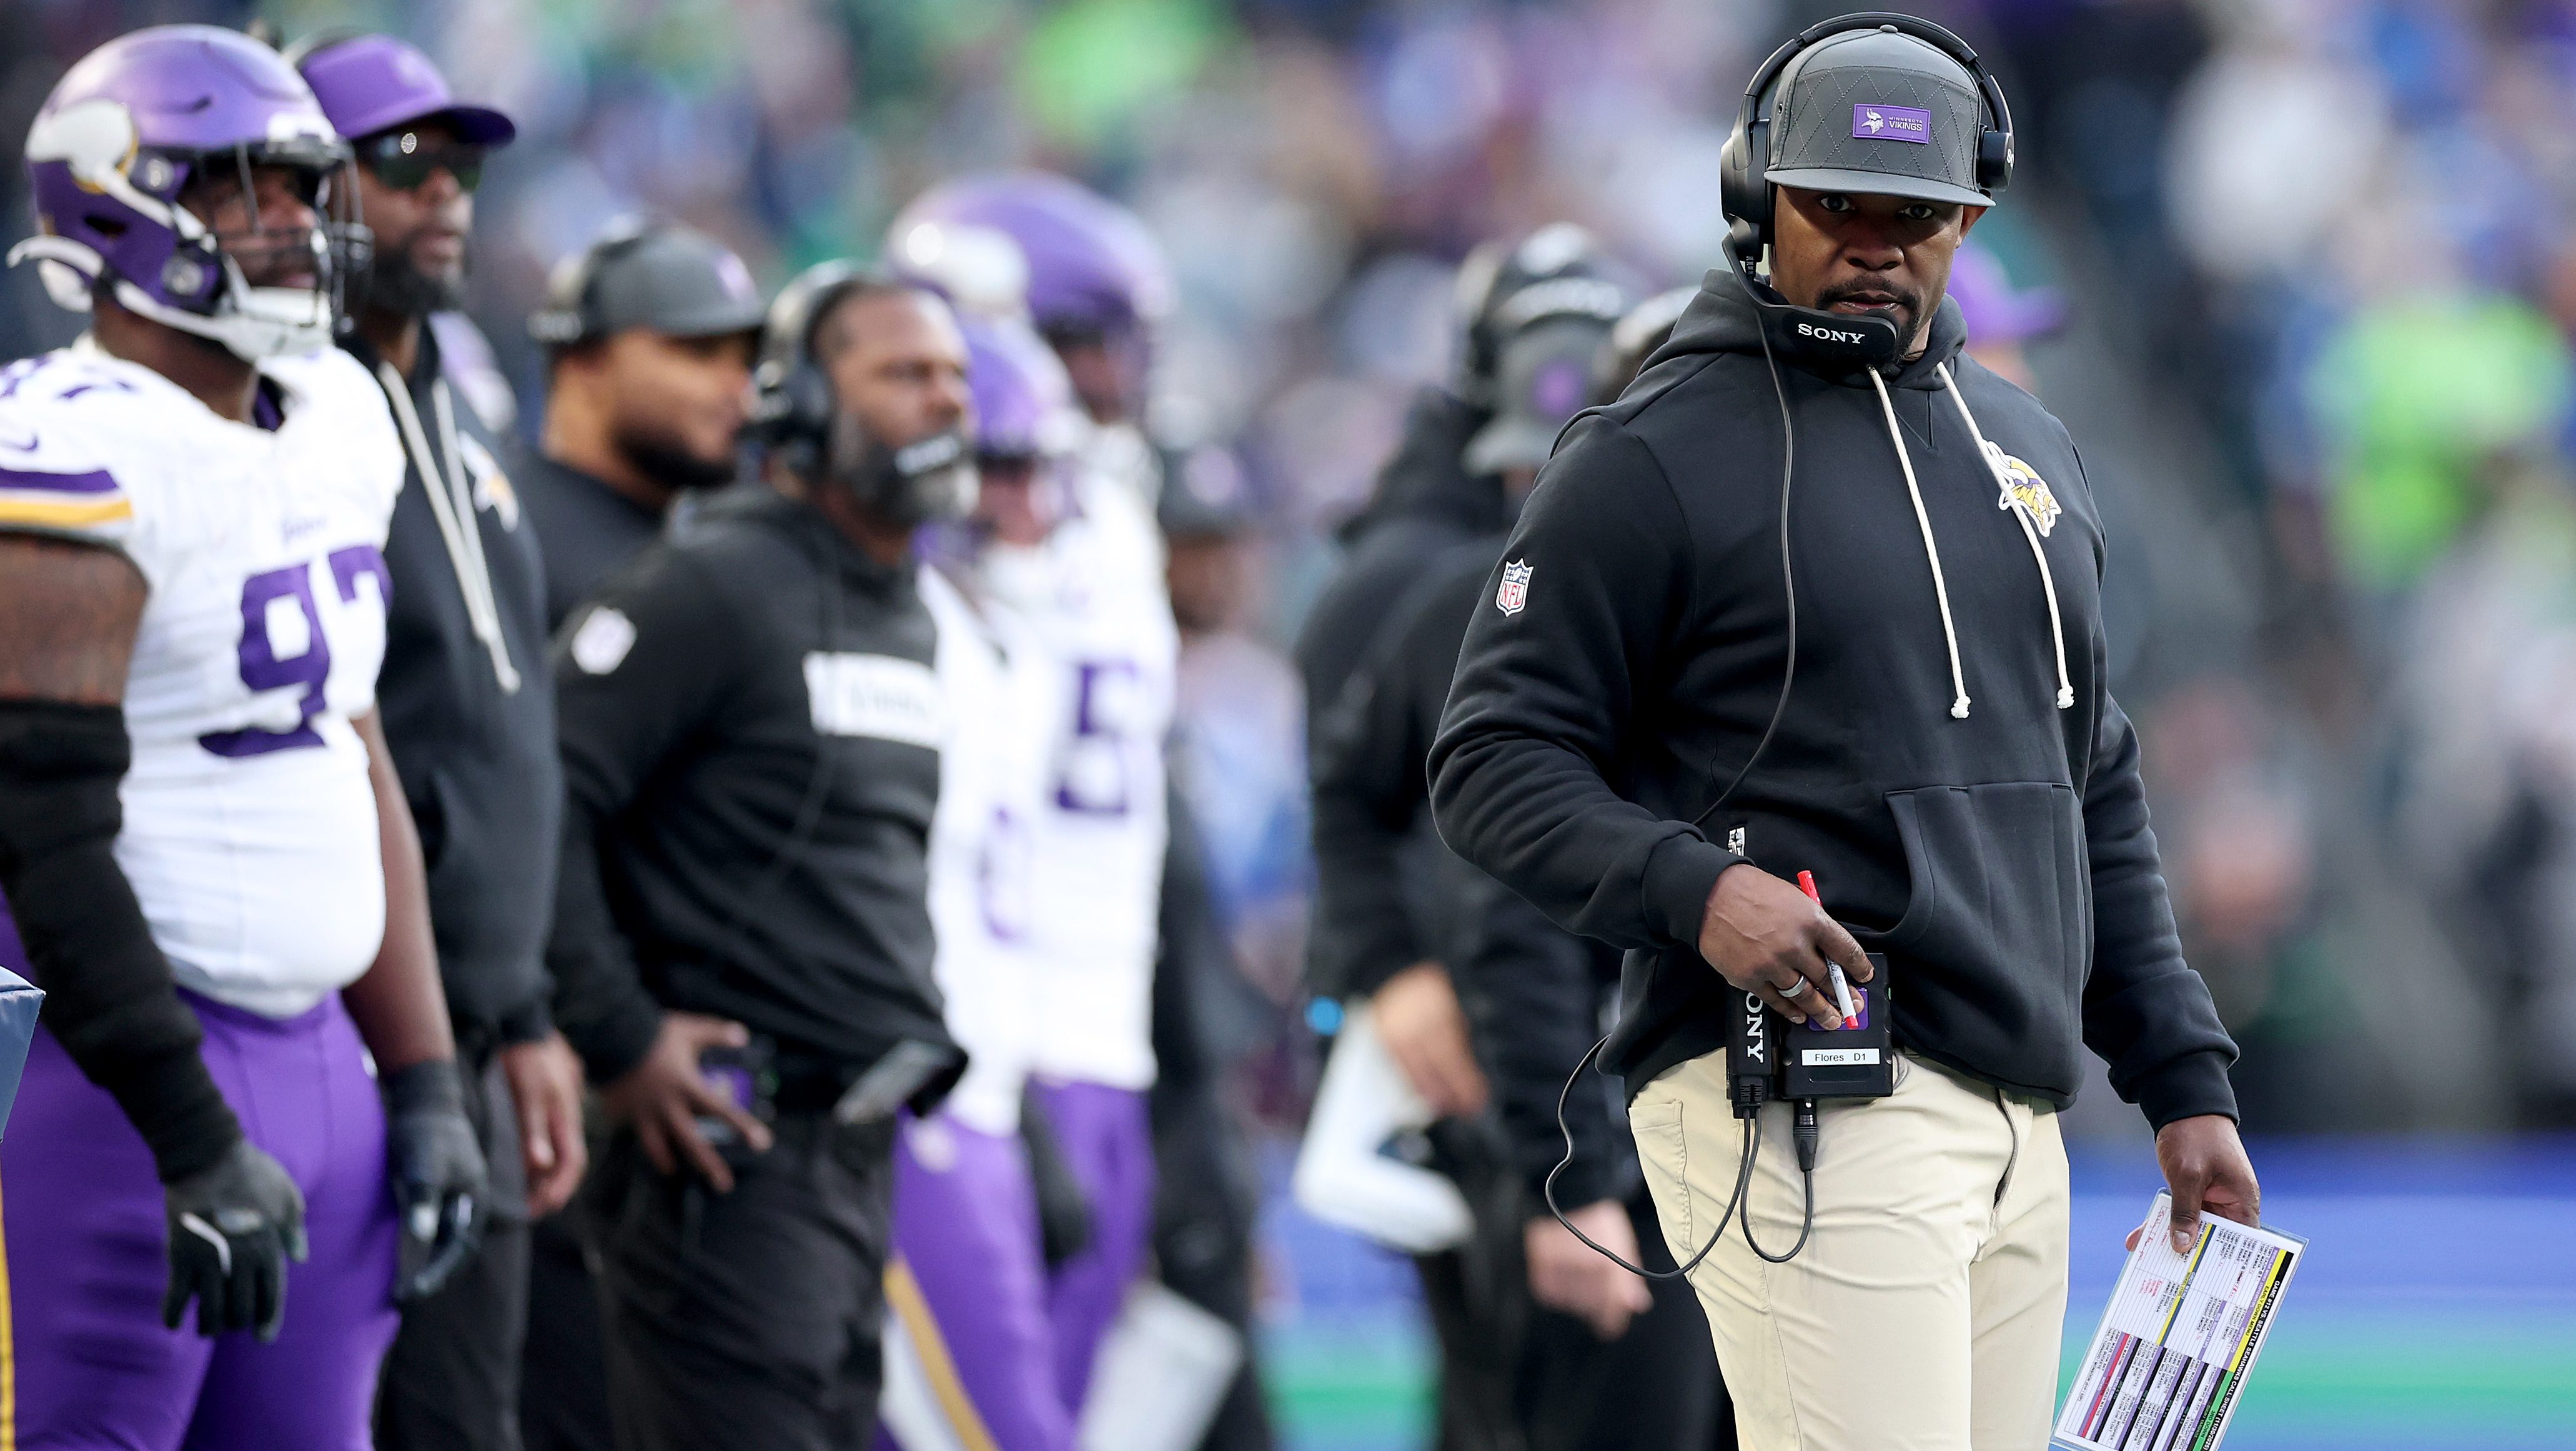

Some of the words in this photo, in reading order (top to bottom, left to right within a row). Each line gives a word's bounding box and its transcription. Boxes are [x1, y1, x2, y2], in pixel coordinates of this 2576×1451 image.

[1888, 121, 1923, 131] VIKINGS
[1798, 324, 1865, 344] SONY
[1500, 583, 1522, 608] NFL
[1815, 1053, 1844, 1061] Flores
[2259, 1285, 2269, 1302] EARLY
[2269, 1280, 2280, 1298] GAME
[2202, 1296, 2213, 1316] STRAIGHT
[2207, 1297, 2217, 1317] STRAIGHT
[2211, 1299, 2221, 1319] STRAIGHT
[2252, 1303, 2261, 1320] DOWN
[2264, 1298, 2272, 1309] #12
[2236, 1309, 2246, 1328] STRAIGHT
[2245, 1320, 2254, 1335] MENU
[2248, 1319, 2263, 1346] SEATTLE
[2234, 1346, 2251, 1380] SEAHAWKS
[2226, 1380, 2236, 1396] CALL
[2217, 1397, 2229, 1417] SHEET
[2200, 1420, 2210, 1438] DOWN
[2202, 1416, 2221, 1450] (11/30/2025)
